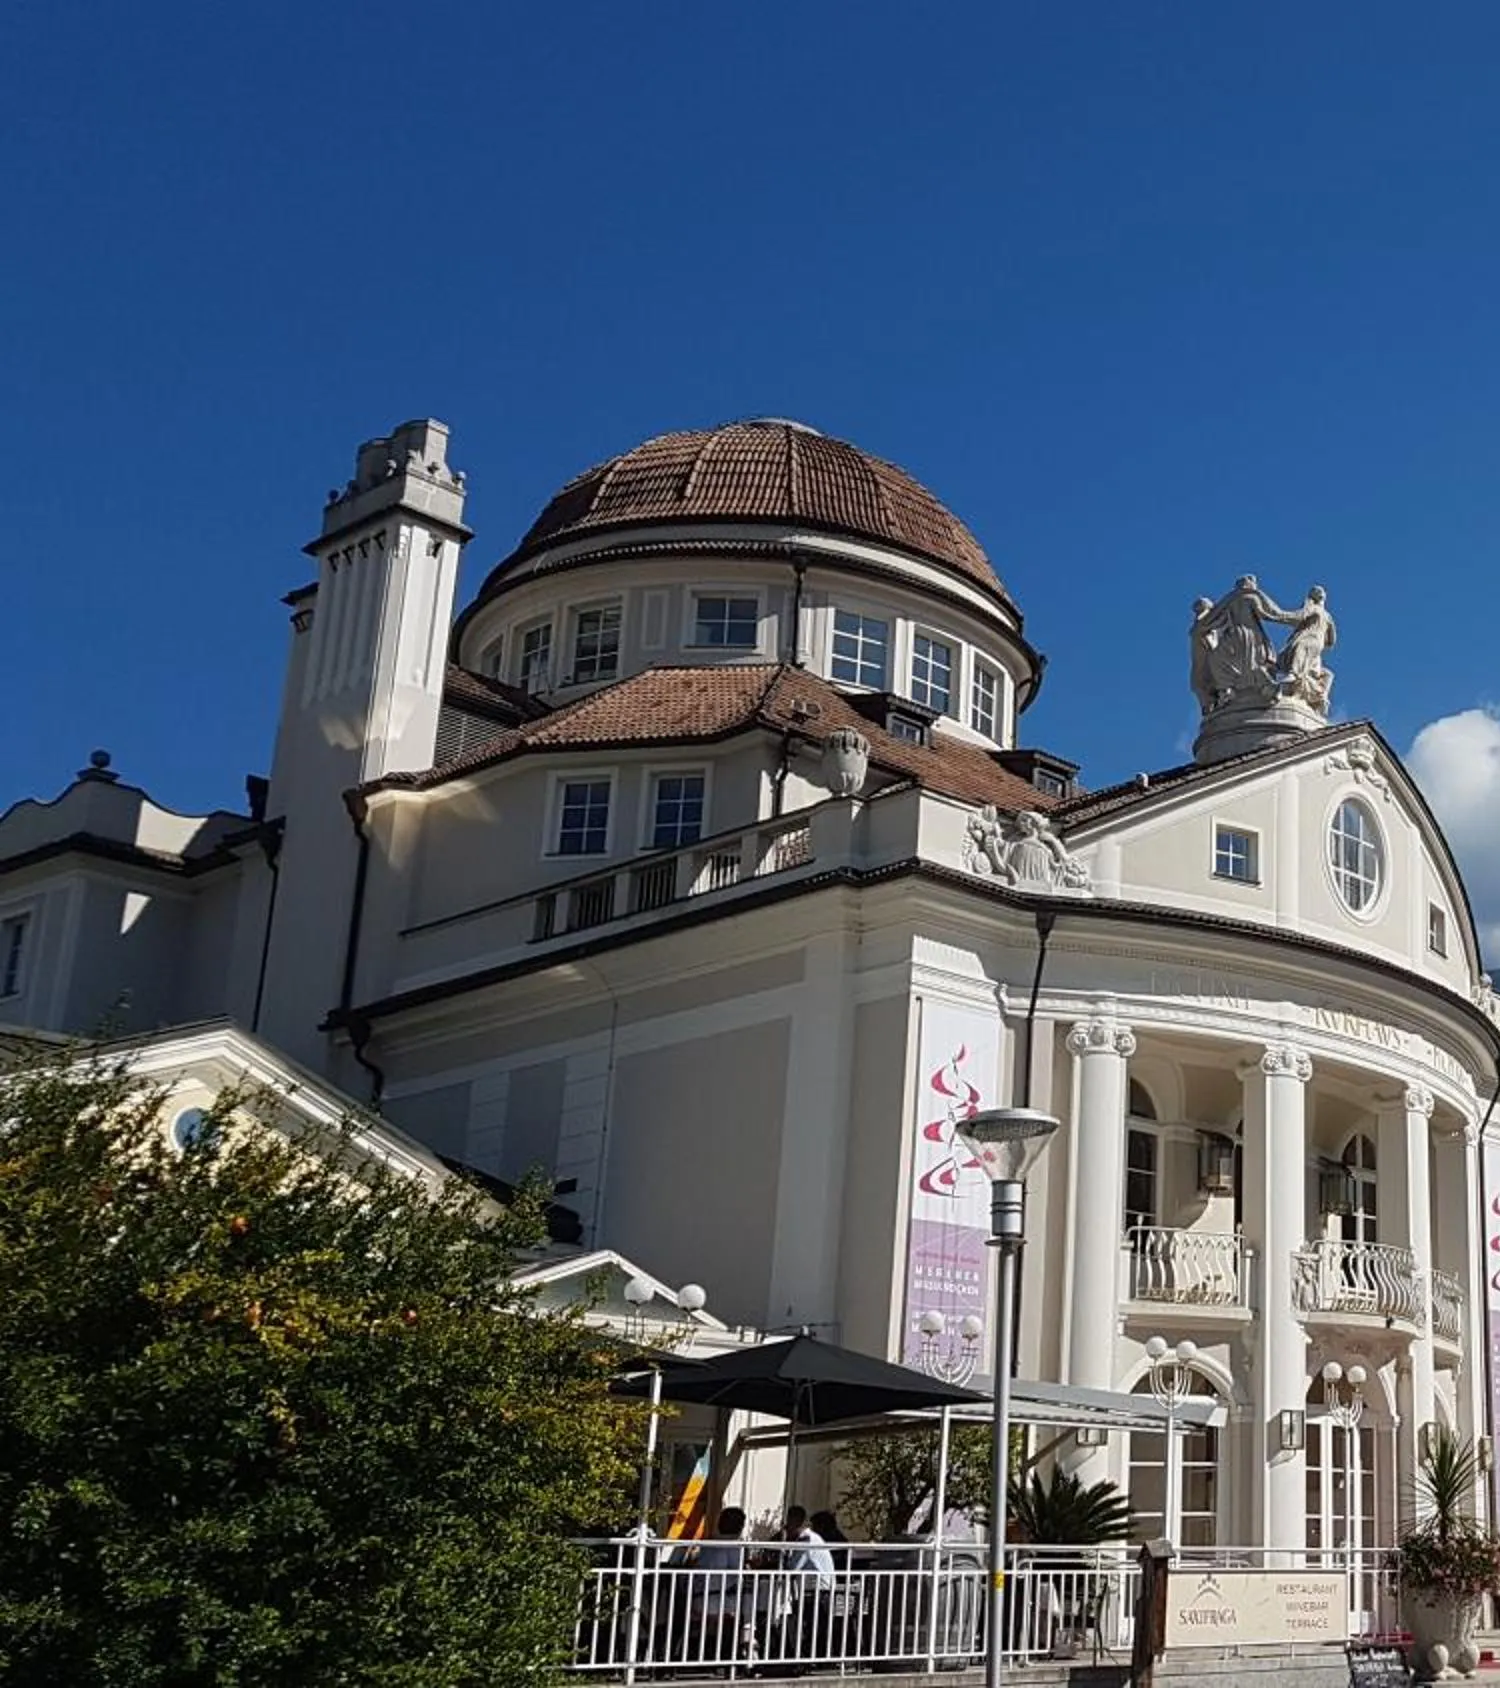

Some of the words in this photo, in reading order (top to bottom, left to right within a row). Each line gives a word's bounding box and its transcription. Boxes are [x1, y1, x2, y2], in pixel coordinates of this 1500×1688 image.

[1276, 1583, 1338, 1595] RESTAURANT
[1285, 1601, 1329, 1612] WINEBAR
[1285, 1617, 1329, 1629] TERRACE
